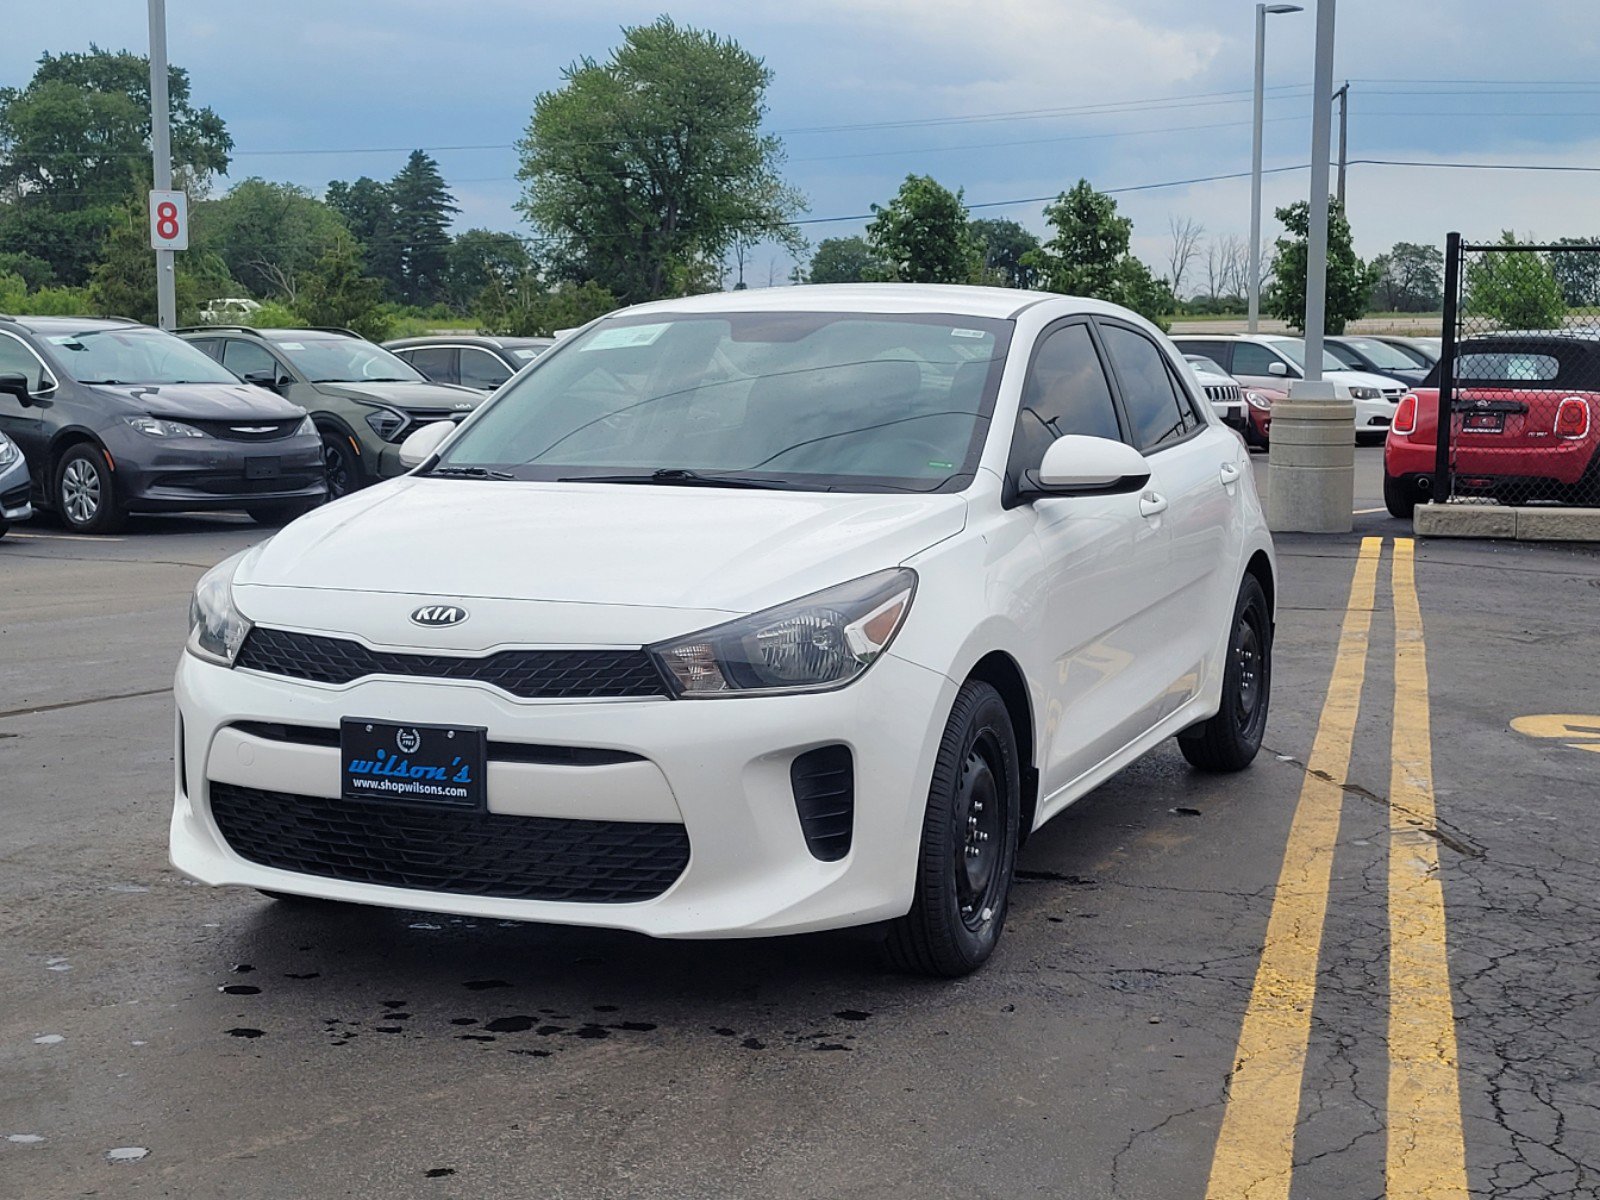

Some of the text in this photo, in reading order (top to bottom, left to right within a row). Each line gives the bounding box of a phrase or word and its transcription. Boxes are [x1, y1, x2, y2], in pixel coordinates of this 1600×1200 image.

[157, 201, 179, 240] 8
[416, 606, 457, 622] KIA
[349, 749, 472, 783] wilson's
[352, 779, 468, 797] www.shopwilsons.com
